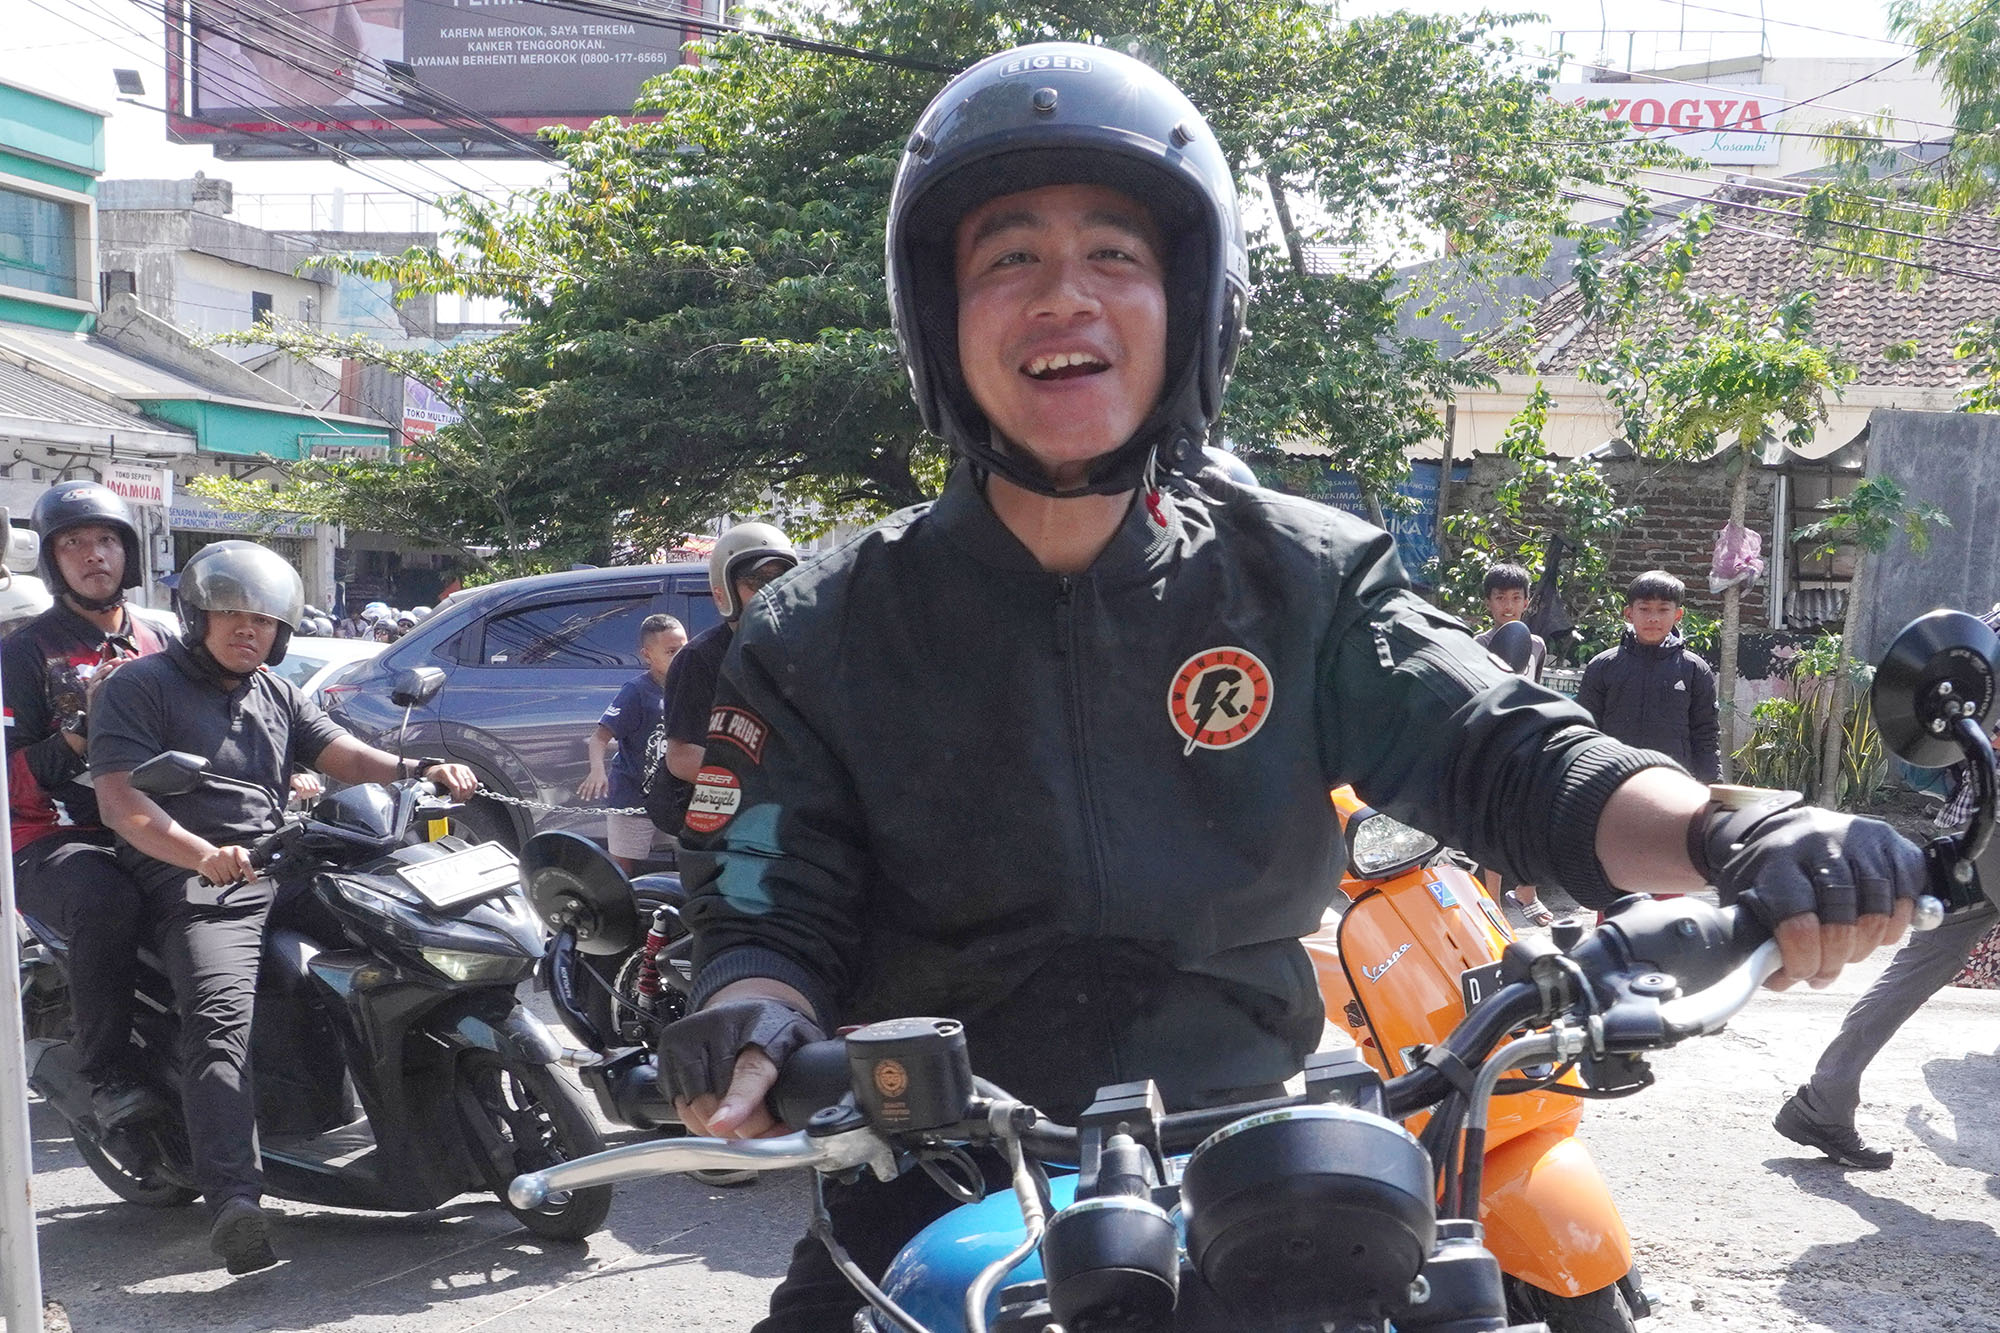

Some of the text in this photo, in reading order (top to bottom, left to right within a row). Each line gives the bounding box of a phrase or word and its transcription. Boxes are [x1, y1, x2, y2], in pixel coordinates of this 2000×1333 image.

[440, 24, 635, 38] KARENA MEROKOK, SAYA TERKENA
[468, 40, 606, 52] KANKER TENGGOROKAN.
[411, 53, 667, 67] LAYANAN BERHENTI MEROKOK (0800-177-6565)
[1007, 56, 1085, 73] EIGER
[1602, 98, 1767, 134] YOGYA
[1701, 132, 1767, 152] Kosambi
[406, 408, 426, 419] TOKO
[115, 470, 151, 482] TOKO SEPATU
[199, 510, 218, 520] ANGIN
[183, 519, 210, 528] PANCING
[727, 713, 761, 750] PRIDE
[1361, 943, 1413, 983] Vespa
[1468, 977, 1482, 1005] D
